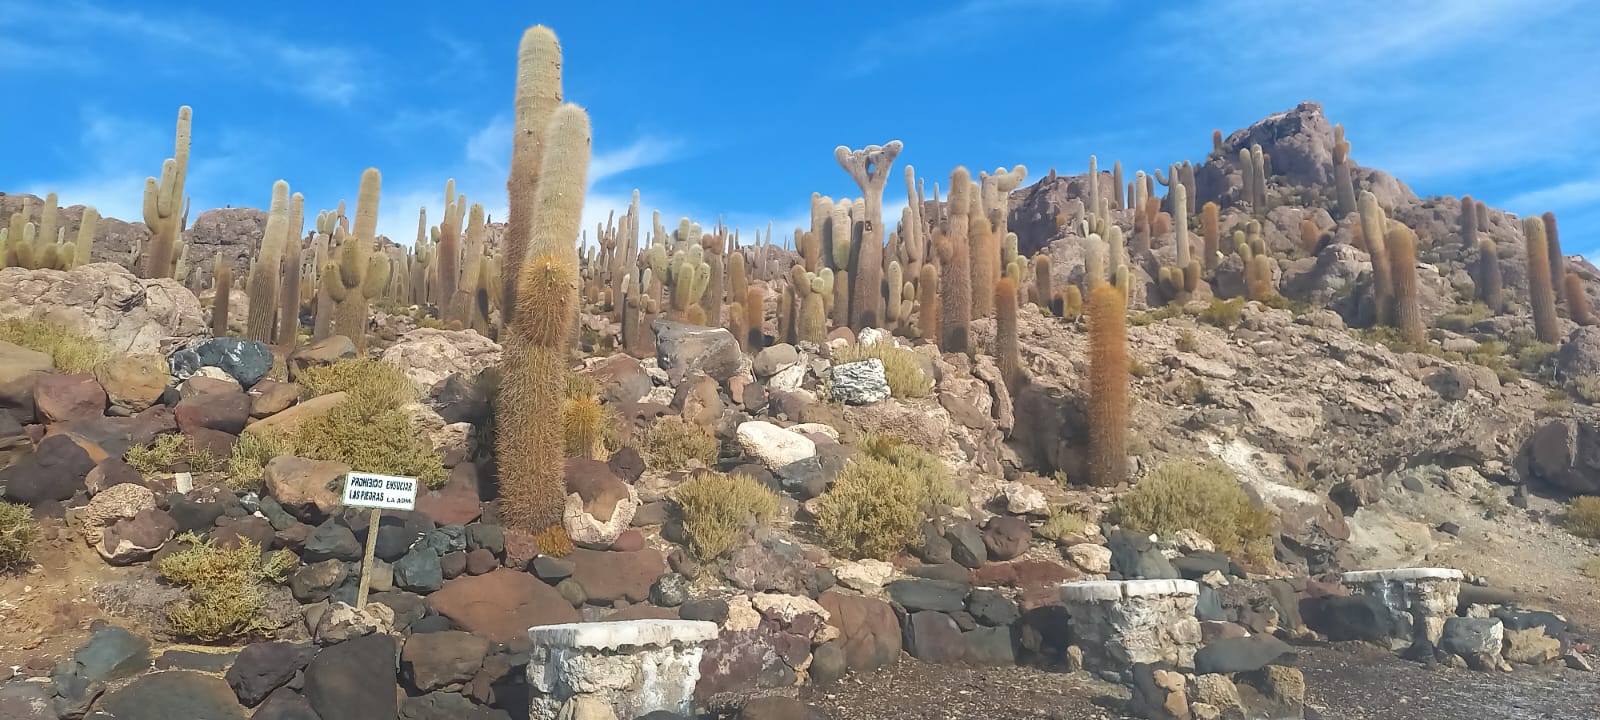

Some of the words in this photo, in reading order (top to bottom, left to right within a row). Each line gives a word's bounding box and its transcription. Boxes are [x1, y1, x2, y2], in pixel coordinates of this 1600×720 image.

[351, 477, 383, 488] PROHIBIDO
[386, 480, 412, 491] ENSUCIAR
[349, 490, 360, 499] LAS
[360, 490, 384, 501] PIEDRAS
